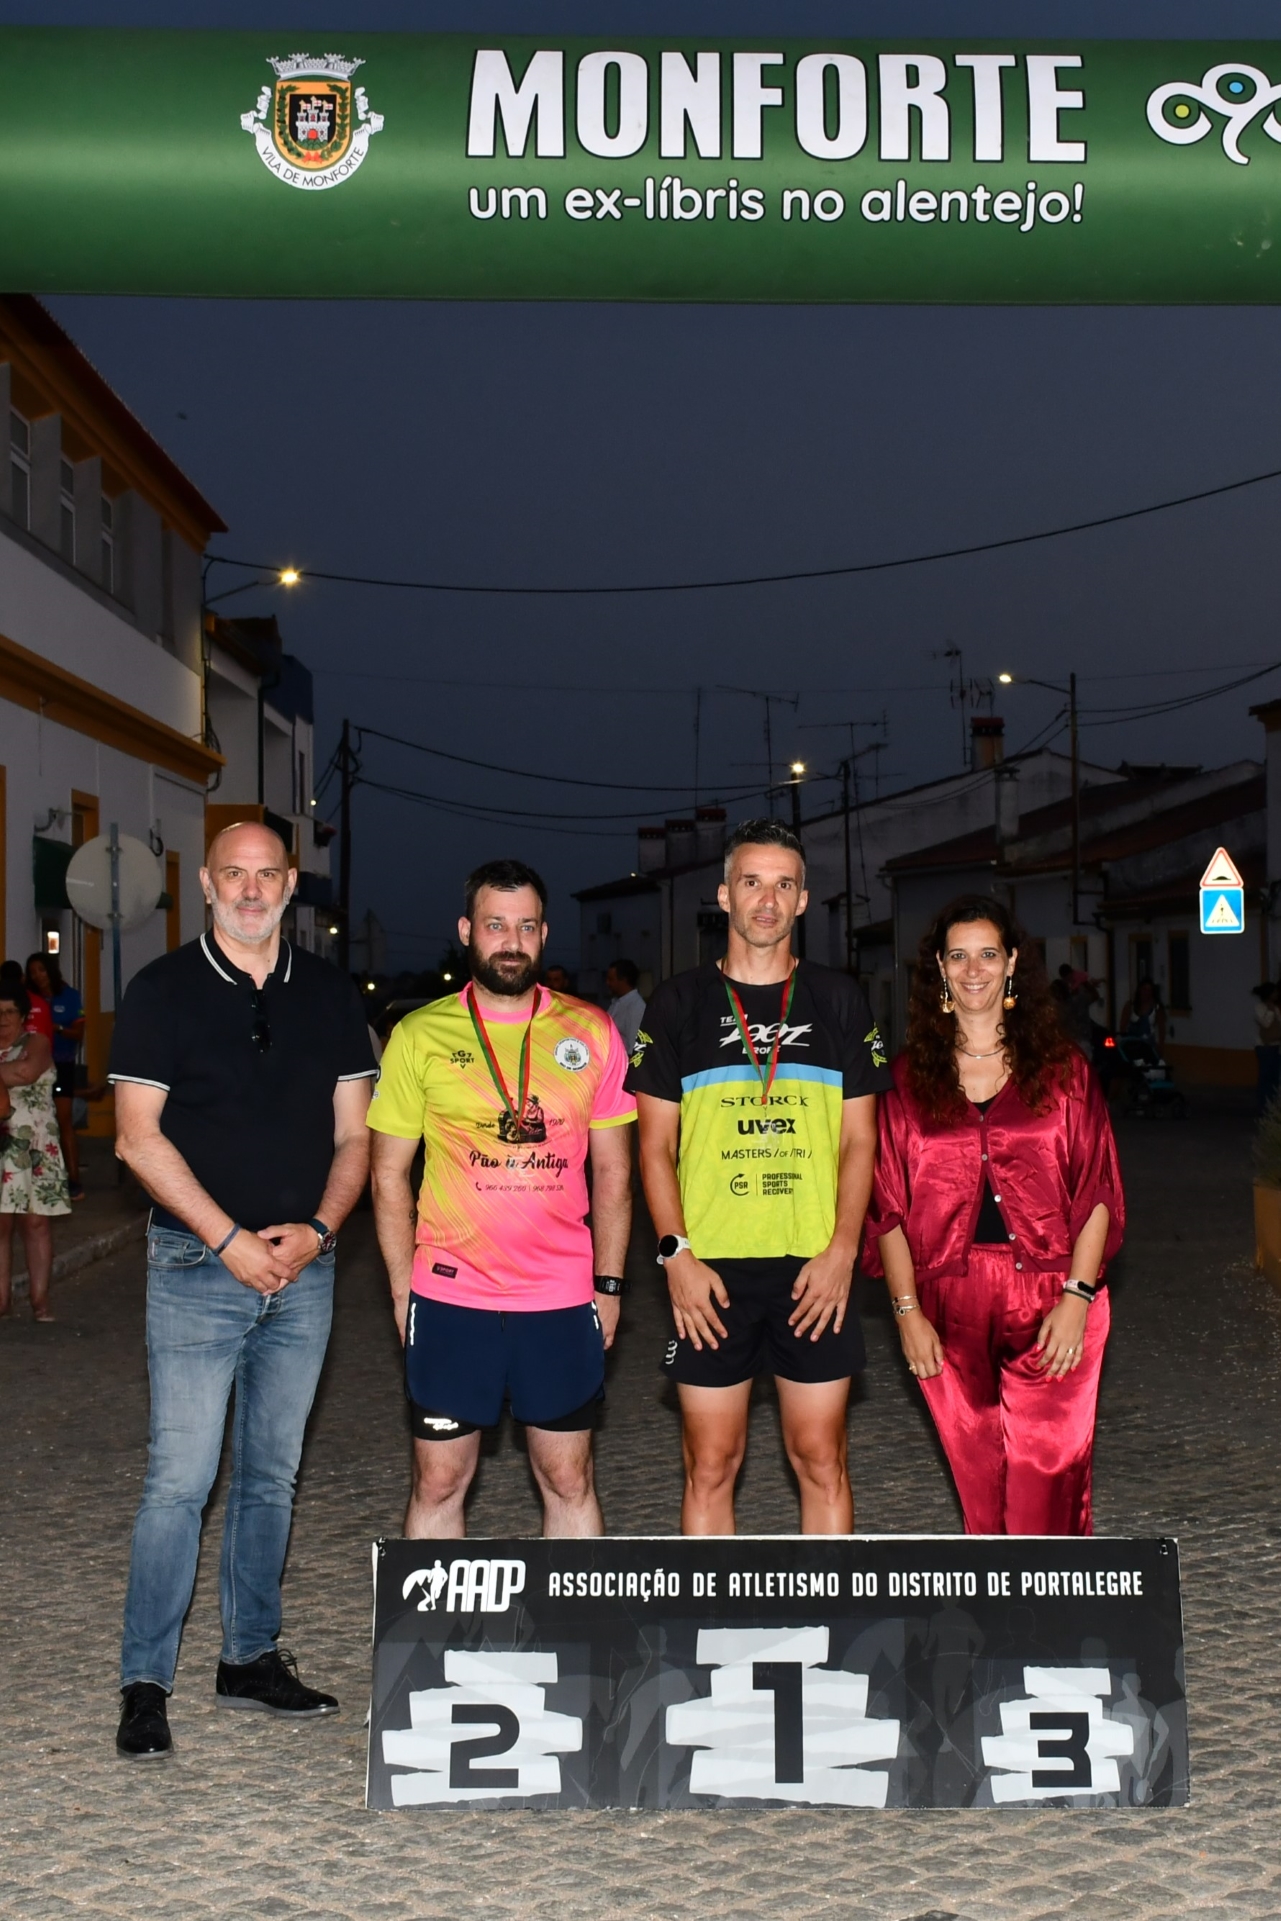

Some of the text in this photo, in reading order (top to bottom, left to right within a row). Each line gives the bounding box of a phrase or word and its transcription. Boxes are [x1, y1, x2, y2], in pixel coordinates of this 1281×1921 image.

[466, 50, 1087, 162] MONFORTE
[262, 146, 365, 187] VILA DE MONFORTE
[469, 176, 1084, 232] um ex-líbris no alentejo!
[720, 1014, 748, 1024] TE
[742, 1046, 781, 1055] EROP
[720, 1095, 810, 1108] STORCK
[737, 1118, 797, 1135] uvex
[469, 1150, 501, 1169] Pão
[519, 1151, 569, 1178] Antiga
[721, 1149, 772, 1160] MASTERS
[734, 1181, 749, 1190] PSR
[762, 1172, 803, 1181] PROFESSONAL
[762, 1180, 789, 1188] SPORTS
[762, 1188, 794, 1196] RECOVER
[445, 1559, 526, 1613] AADP
[548, 1568, 1143, 1602] ASSOCIAÇÃO DE ATLETISMO DO DISTRITO DE PORTALEGRE
[752, 1661, 804, 1784] 1
[449, 1704, 520, 1789] 2
[1029, 1712, 1092, 1788] 3
